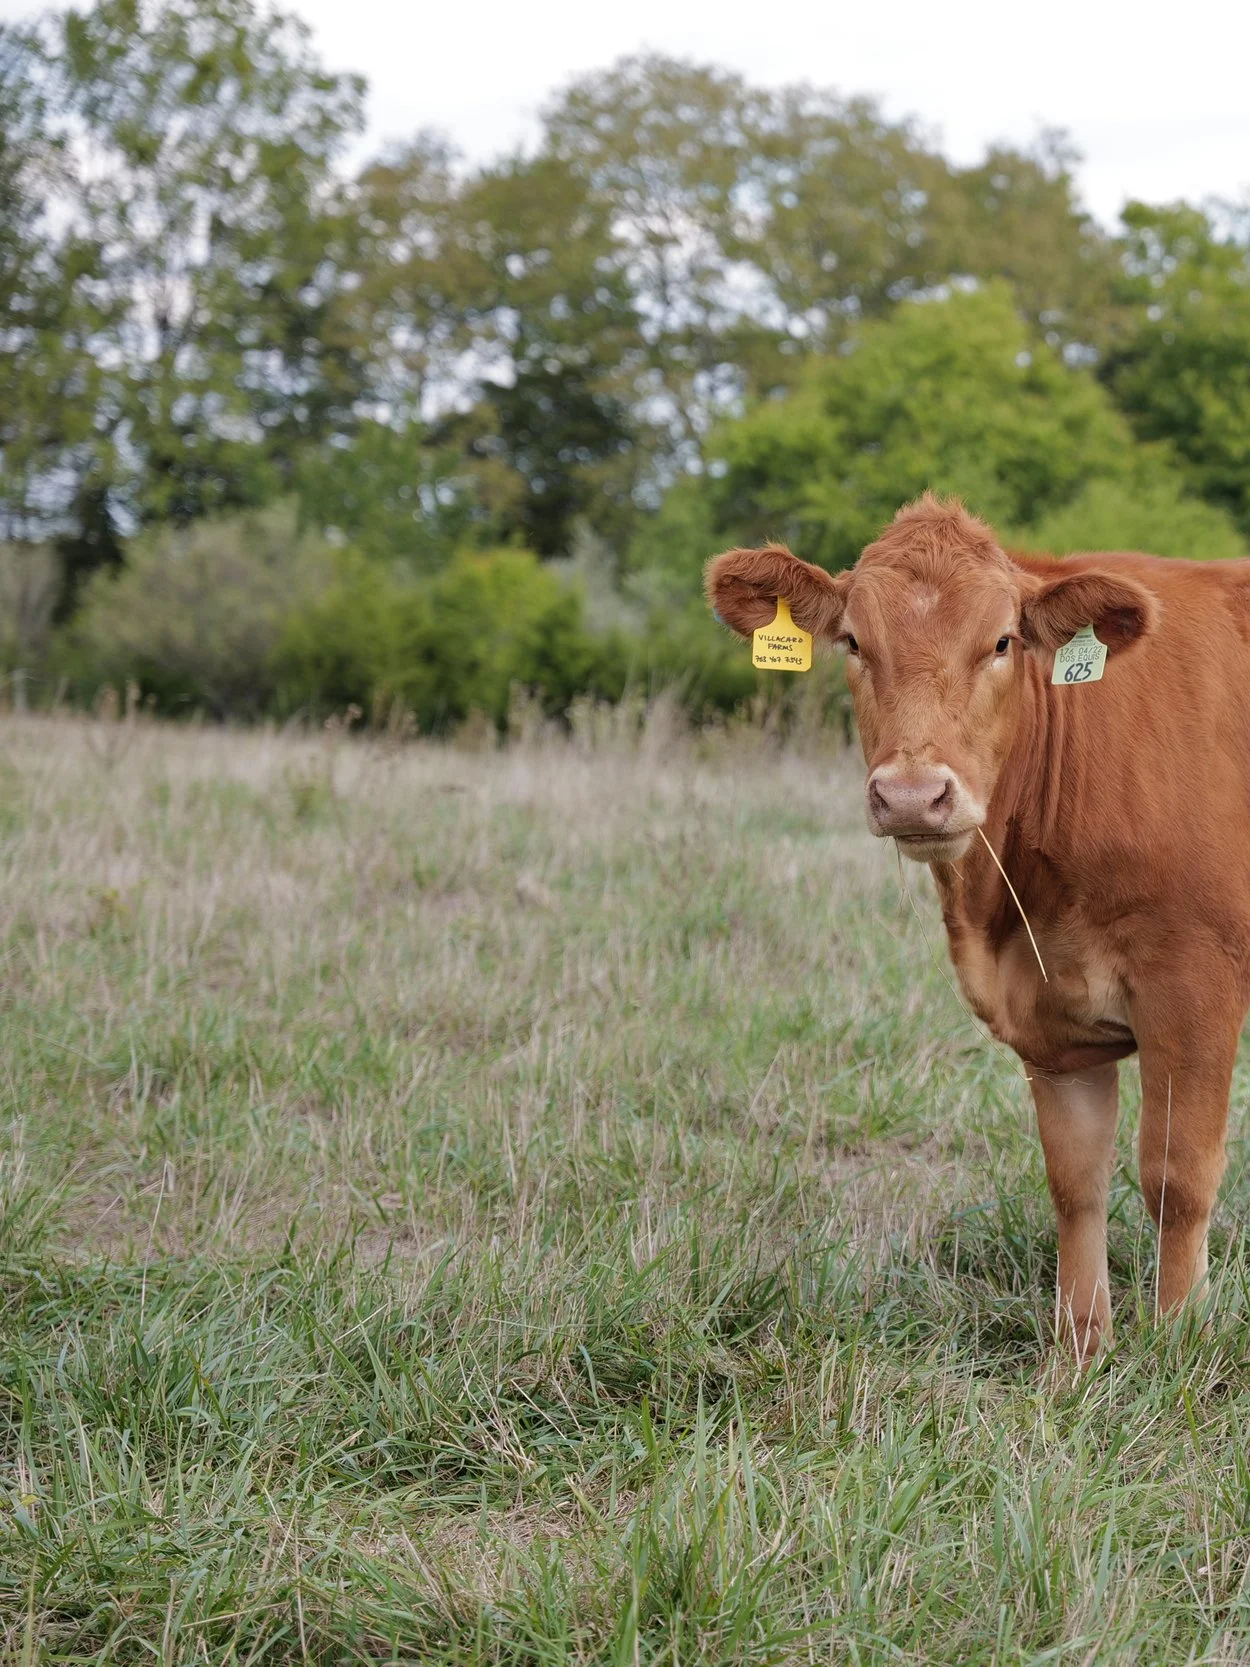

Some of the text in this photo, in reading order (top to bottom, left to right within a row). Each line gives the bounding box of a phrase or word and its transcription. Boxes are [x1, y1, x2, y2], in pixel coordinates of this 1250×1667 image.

[767, 643, 793, 651] FARMS
[1060, 653, 1100, 663] DOS EQUIS
[1064, 661, 1093, 682] 625
